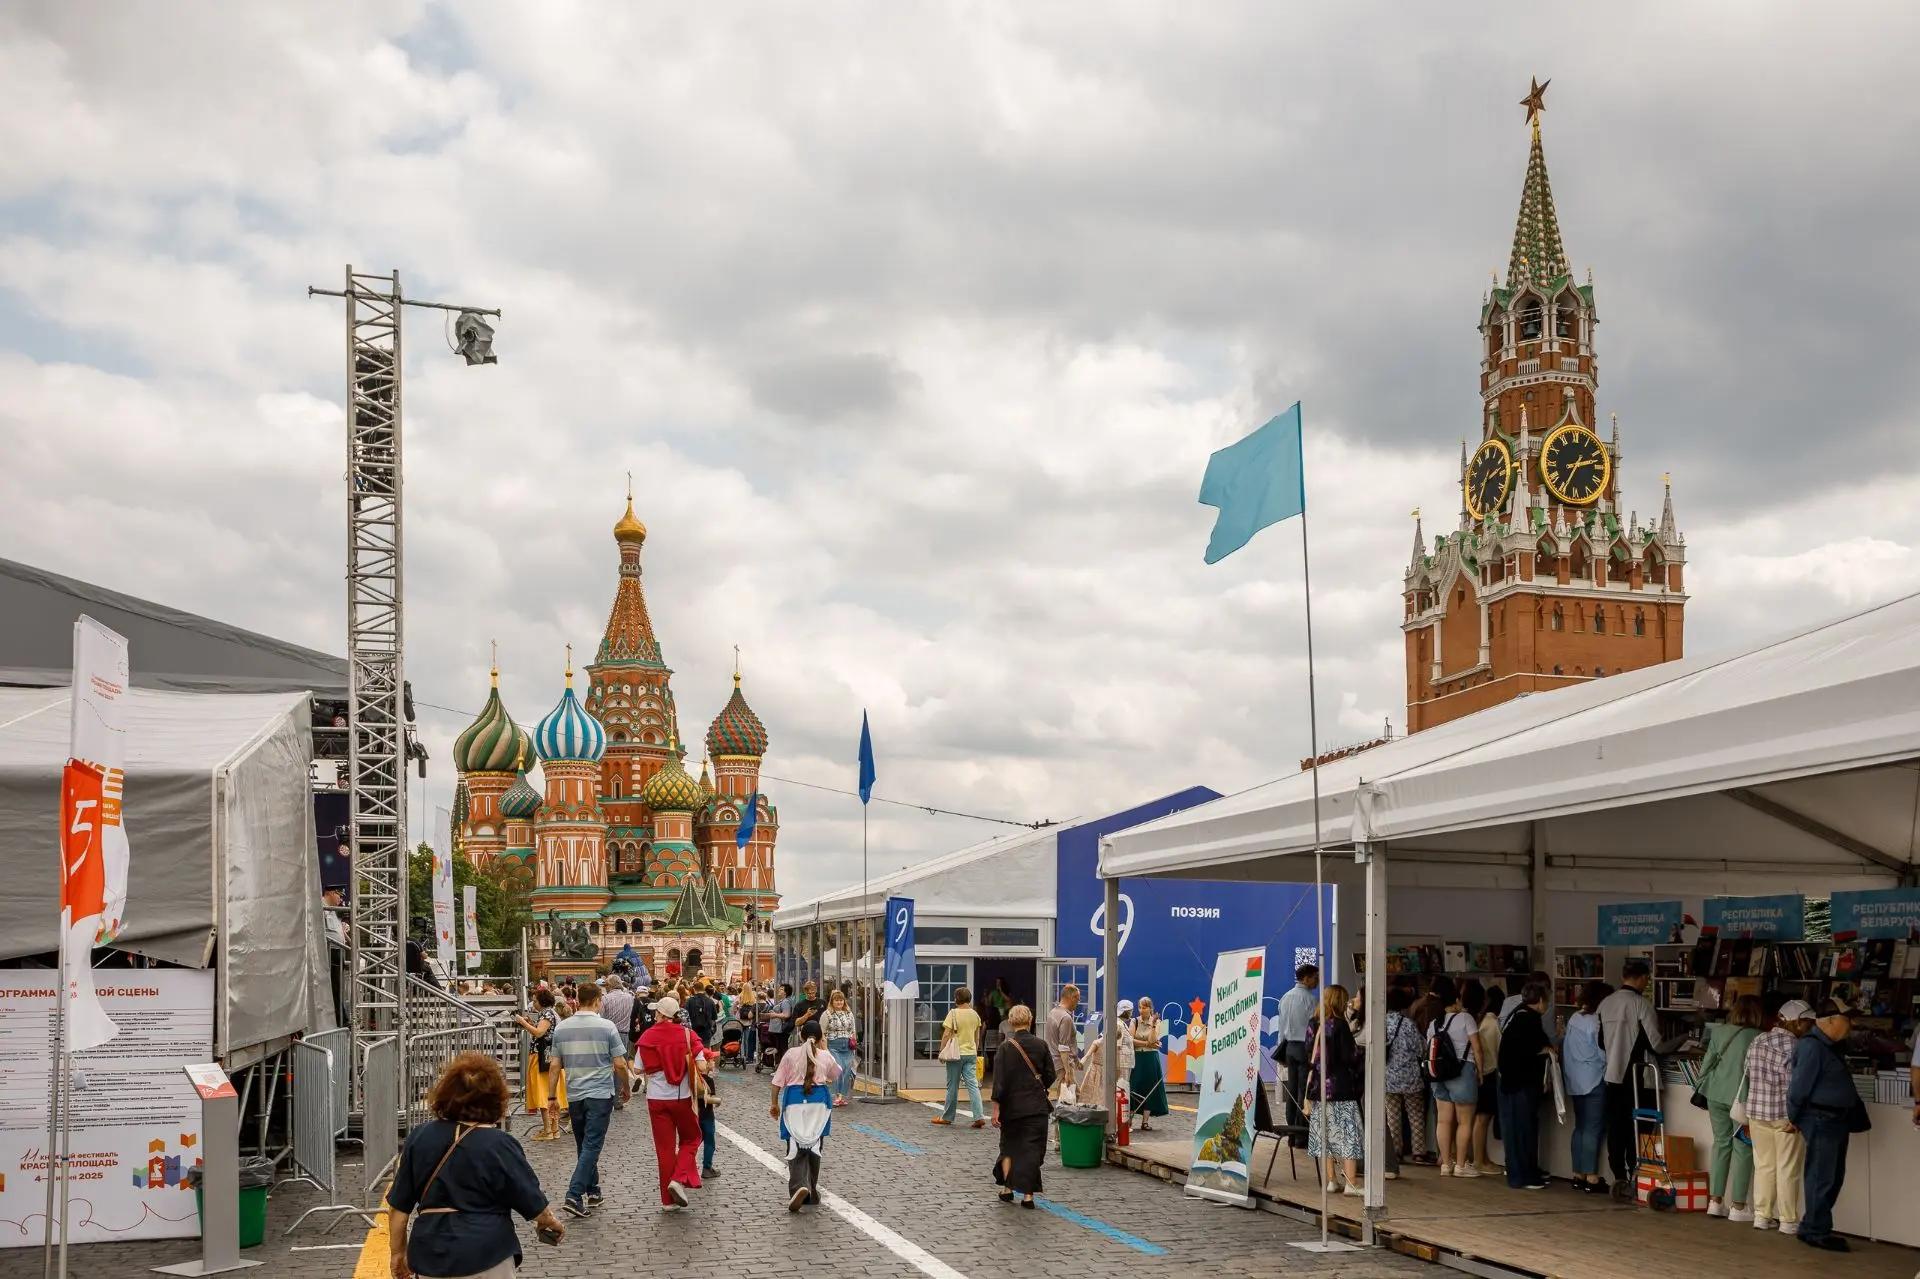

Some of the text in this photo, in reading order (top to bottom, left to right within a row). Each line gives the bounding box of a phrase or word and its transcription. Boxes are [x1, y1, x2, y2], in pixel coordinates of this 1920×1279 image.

[1721, 907, 1784, 919] РЕСПУБЛИКА
[896, 907, 908, 943] 9
[1727, 921, 1777, 932] БЕЛАРУСЬ
[117, 988, 160, 998] СЦЕНЫ
[1216, 979, 1239, 1003] Книги
[1214, 991, 1259, 1030] Республики
[1211, 1024, 1248, 1057] Беларусь
[77, 1151, 119, 1159] ФЕСТИВАЛЬ
[68, 1159, 119, 1168] ПЛОЩАДЬ
[79, 1171, 104, 1180] 2025
